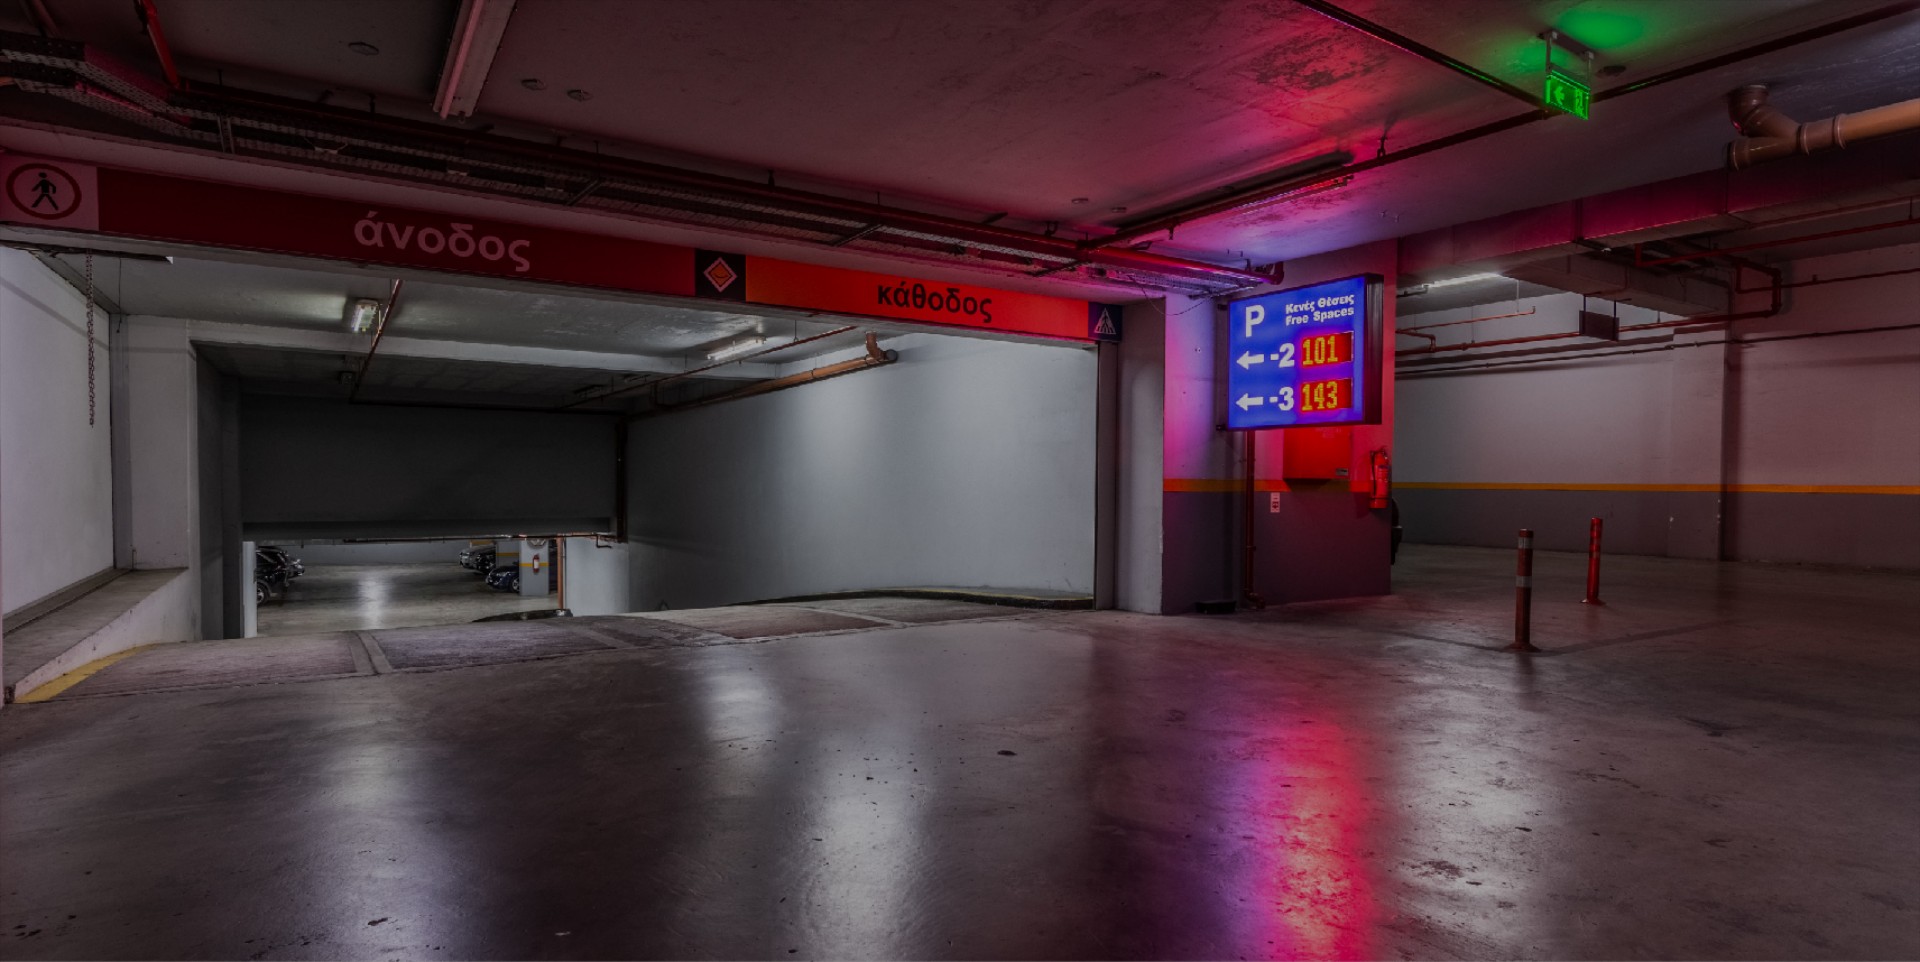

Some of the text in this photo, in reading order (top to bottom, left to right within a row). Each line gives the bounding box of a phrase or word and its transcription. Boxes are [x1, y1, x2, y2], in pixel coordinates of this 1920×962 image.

[354, 210, 531, 272] άνοδος
[877, 281, 992, 323] κάθοδος
[1285, 301, 1315, 315] Κενές
[1285, 307, 1354, 326] Free Spaces
[1245, 304, 1265, 338] P
[1270, 342, 1295, 368] -2
[1302, 336, 1339, 366] 101
[1269, 386, 1294, 411] -3
[1301, 381, 1338, 411] 143
